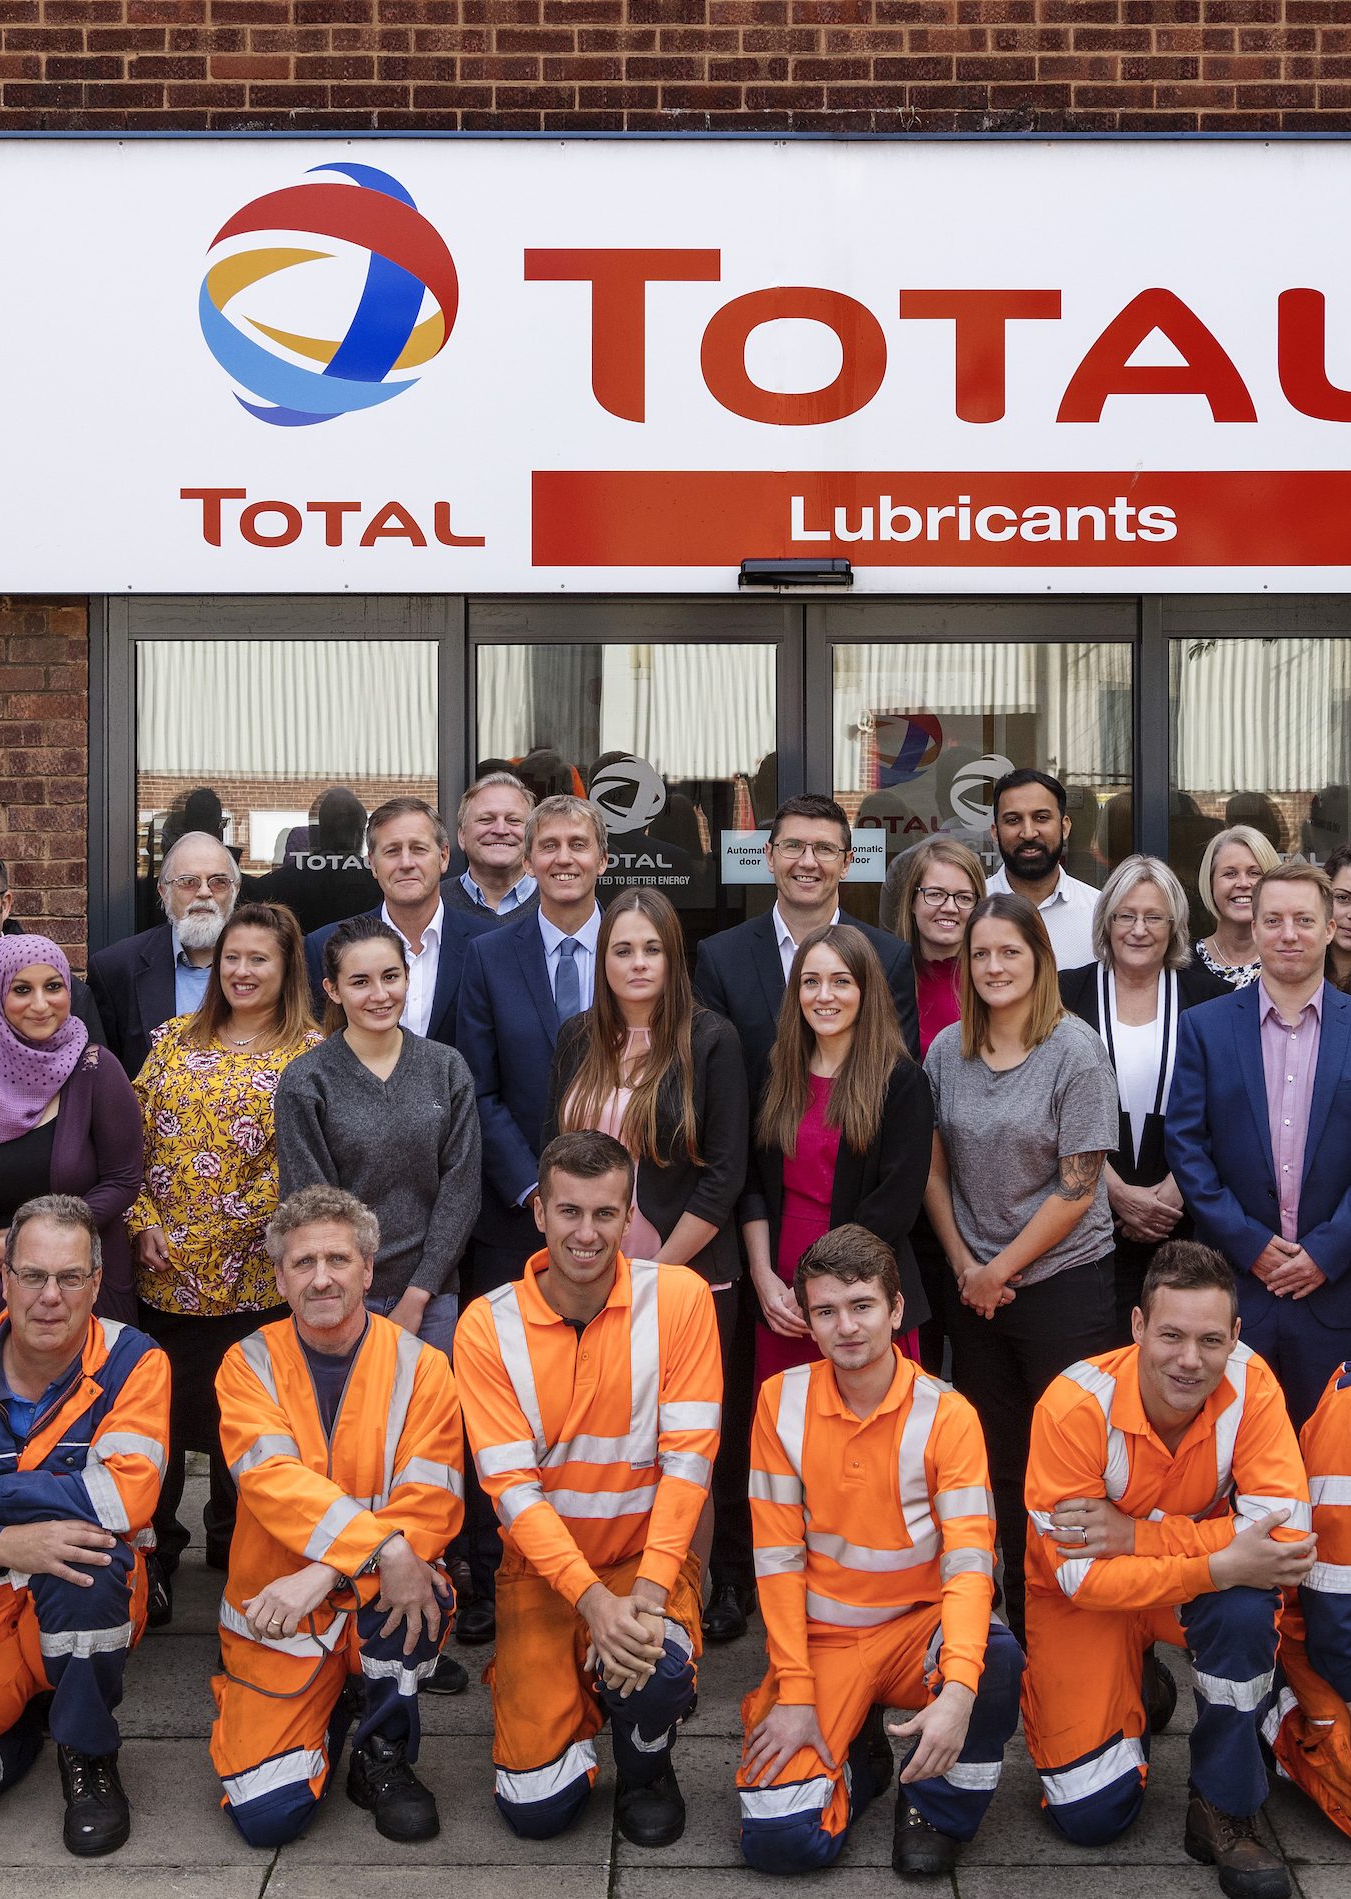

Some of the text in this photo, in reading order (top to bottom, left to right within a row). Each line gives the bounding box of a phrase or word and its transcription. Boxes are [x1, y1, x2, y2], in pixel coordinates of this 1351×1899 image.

[180, 487, 485, 548] TOTAL
[791, 495, 1178, 542] Lubricants
[857, 815, 950, 834] OTAL
[726, 846, 765, 855] Automat
[852, 845, 883, 853] omatic
[607, 853, 673, 869] OTAL
[739, 858, 761, 866] door
[614, 876, 626, 885] TO
[627, 876, 657, 885] BETTER
[658, 876, 690, 885] ENERGY
